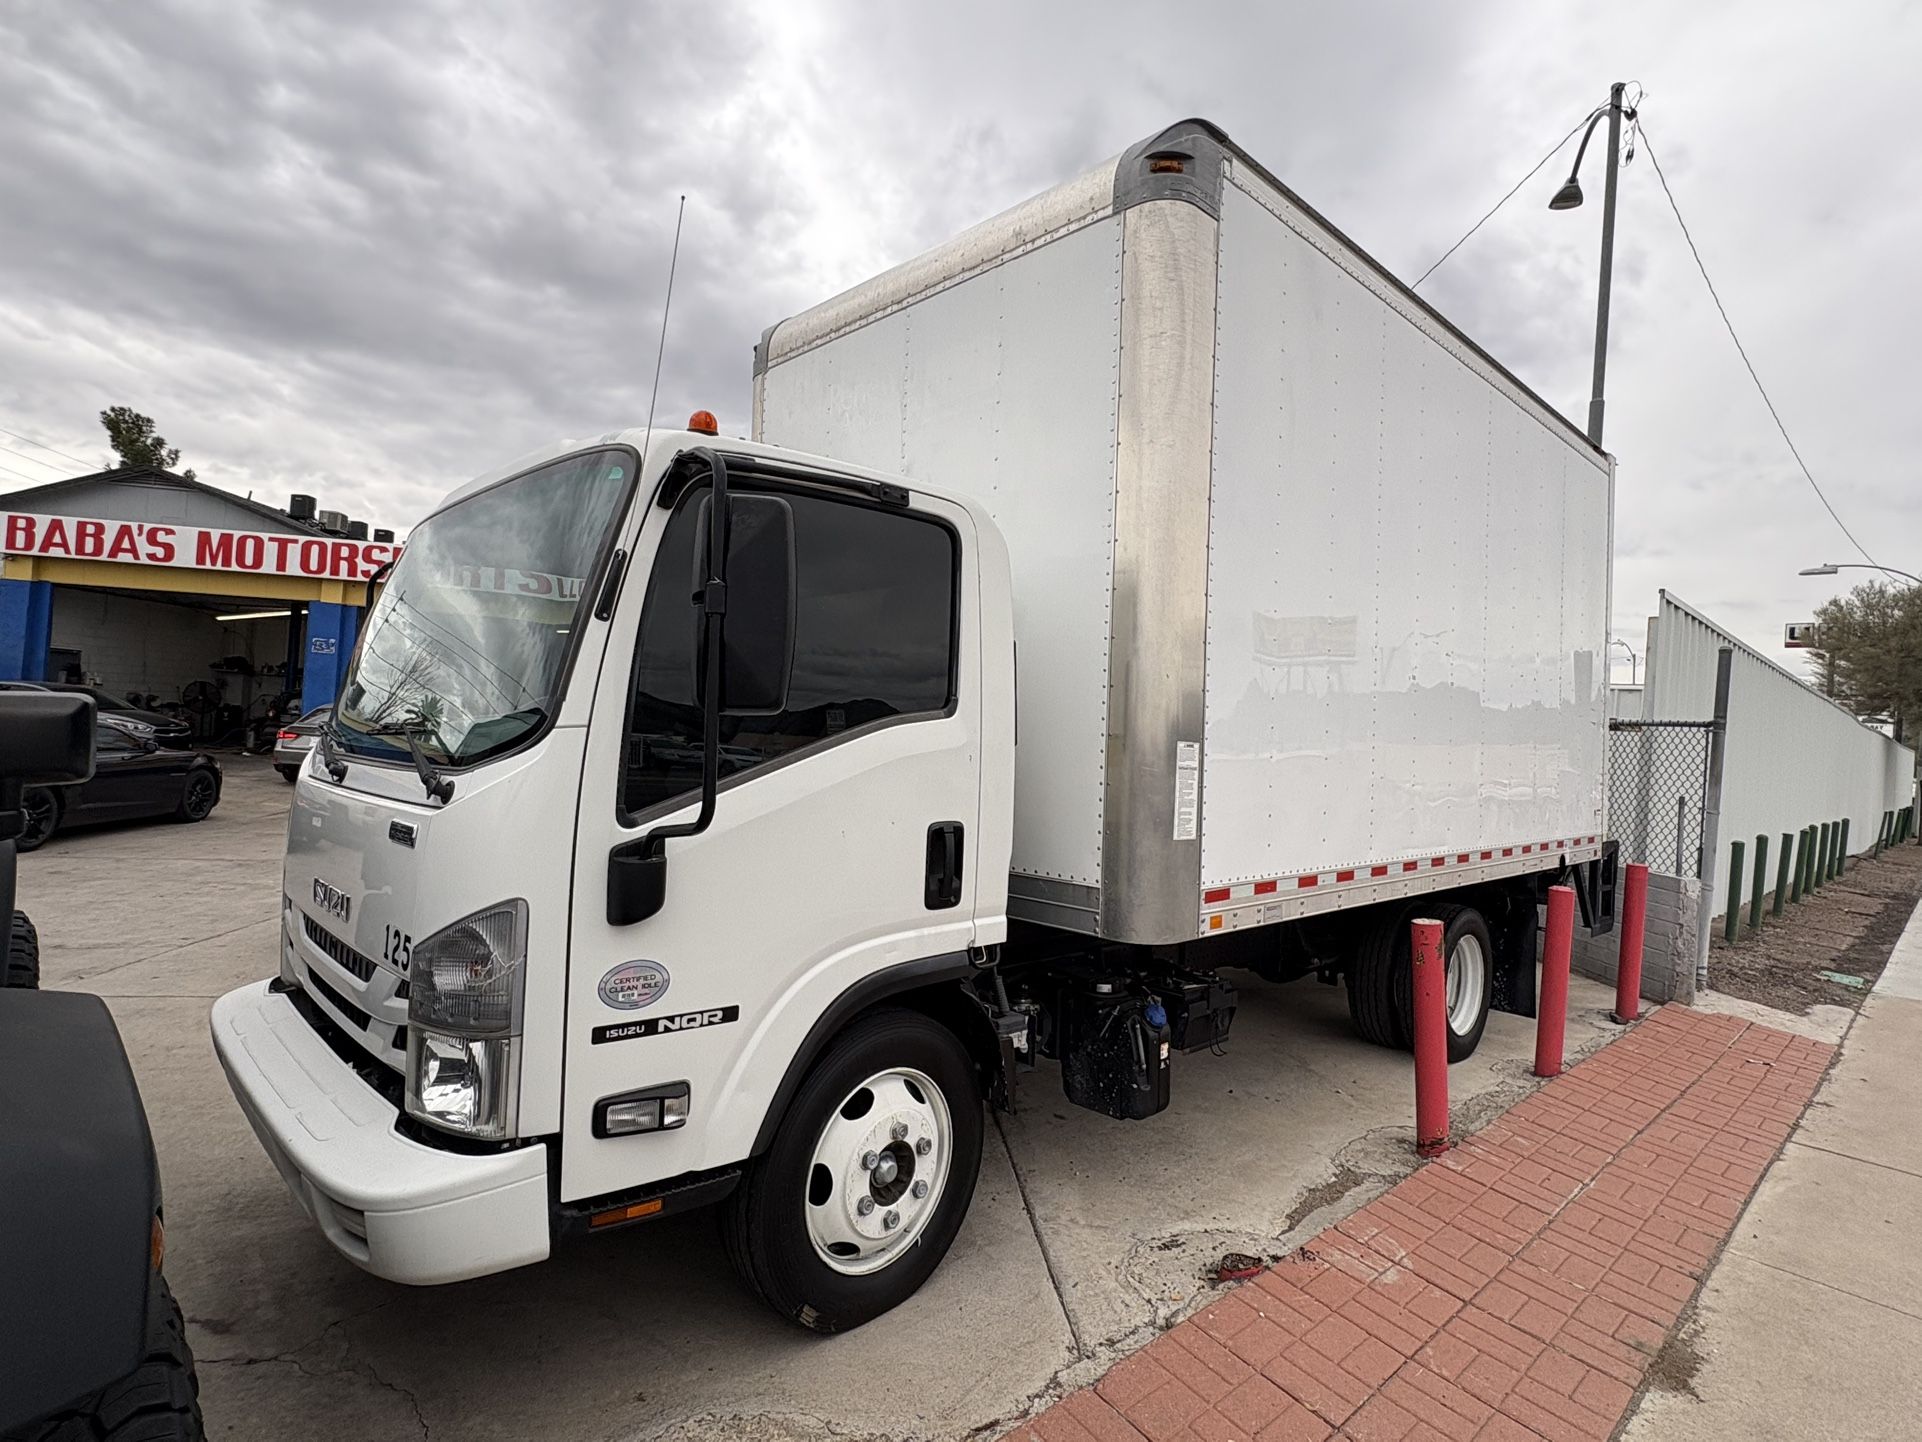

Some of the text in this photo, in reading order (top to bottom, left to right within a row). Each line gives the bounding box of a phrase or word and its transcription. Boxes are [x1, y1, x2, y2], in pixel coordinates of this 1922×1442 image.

[5, 514, 177, 563] BABA'S
[383, 923, 412, 972] 125
[609, 981, 660, 994] CLEAN IDLE
[613, 974, 656, 985] CERTIFIED
[606, 1010, 723, 1038] ISUZU NQR
